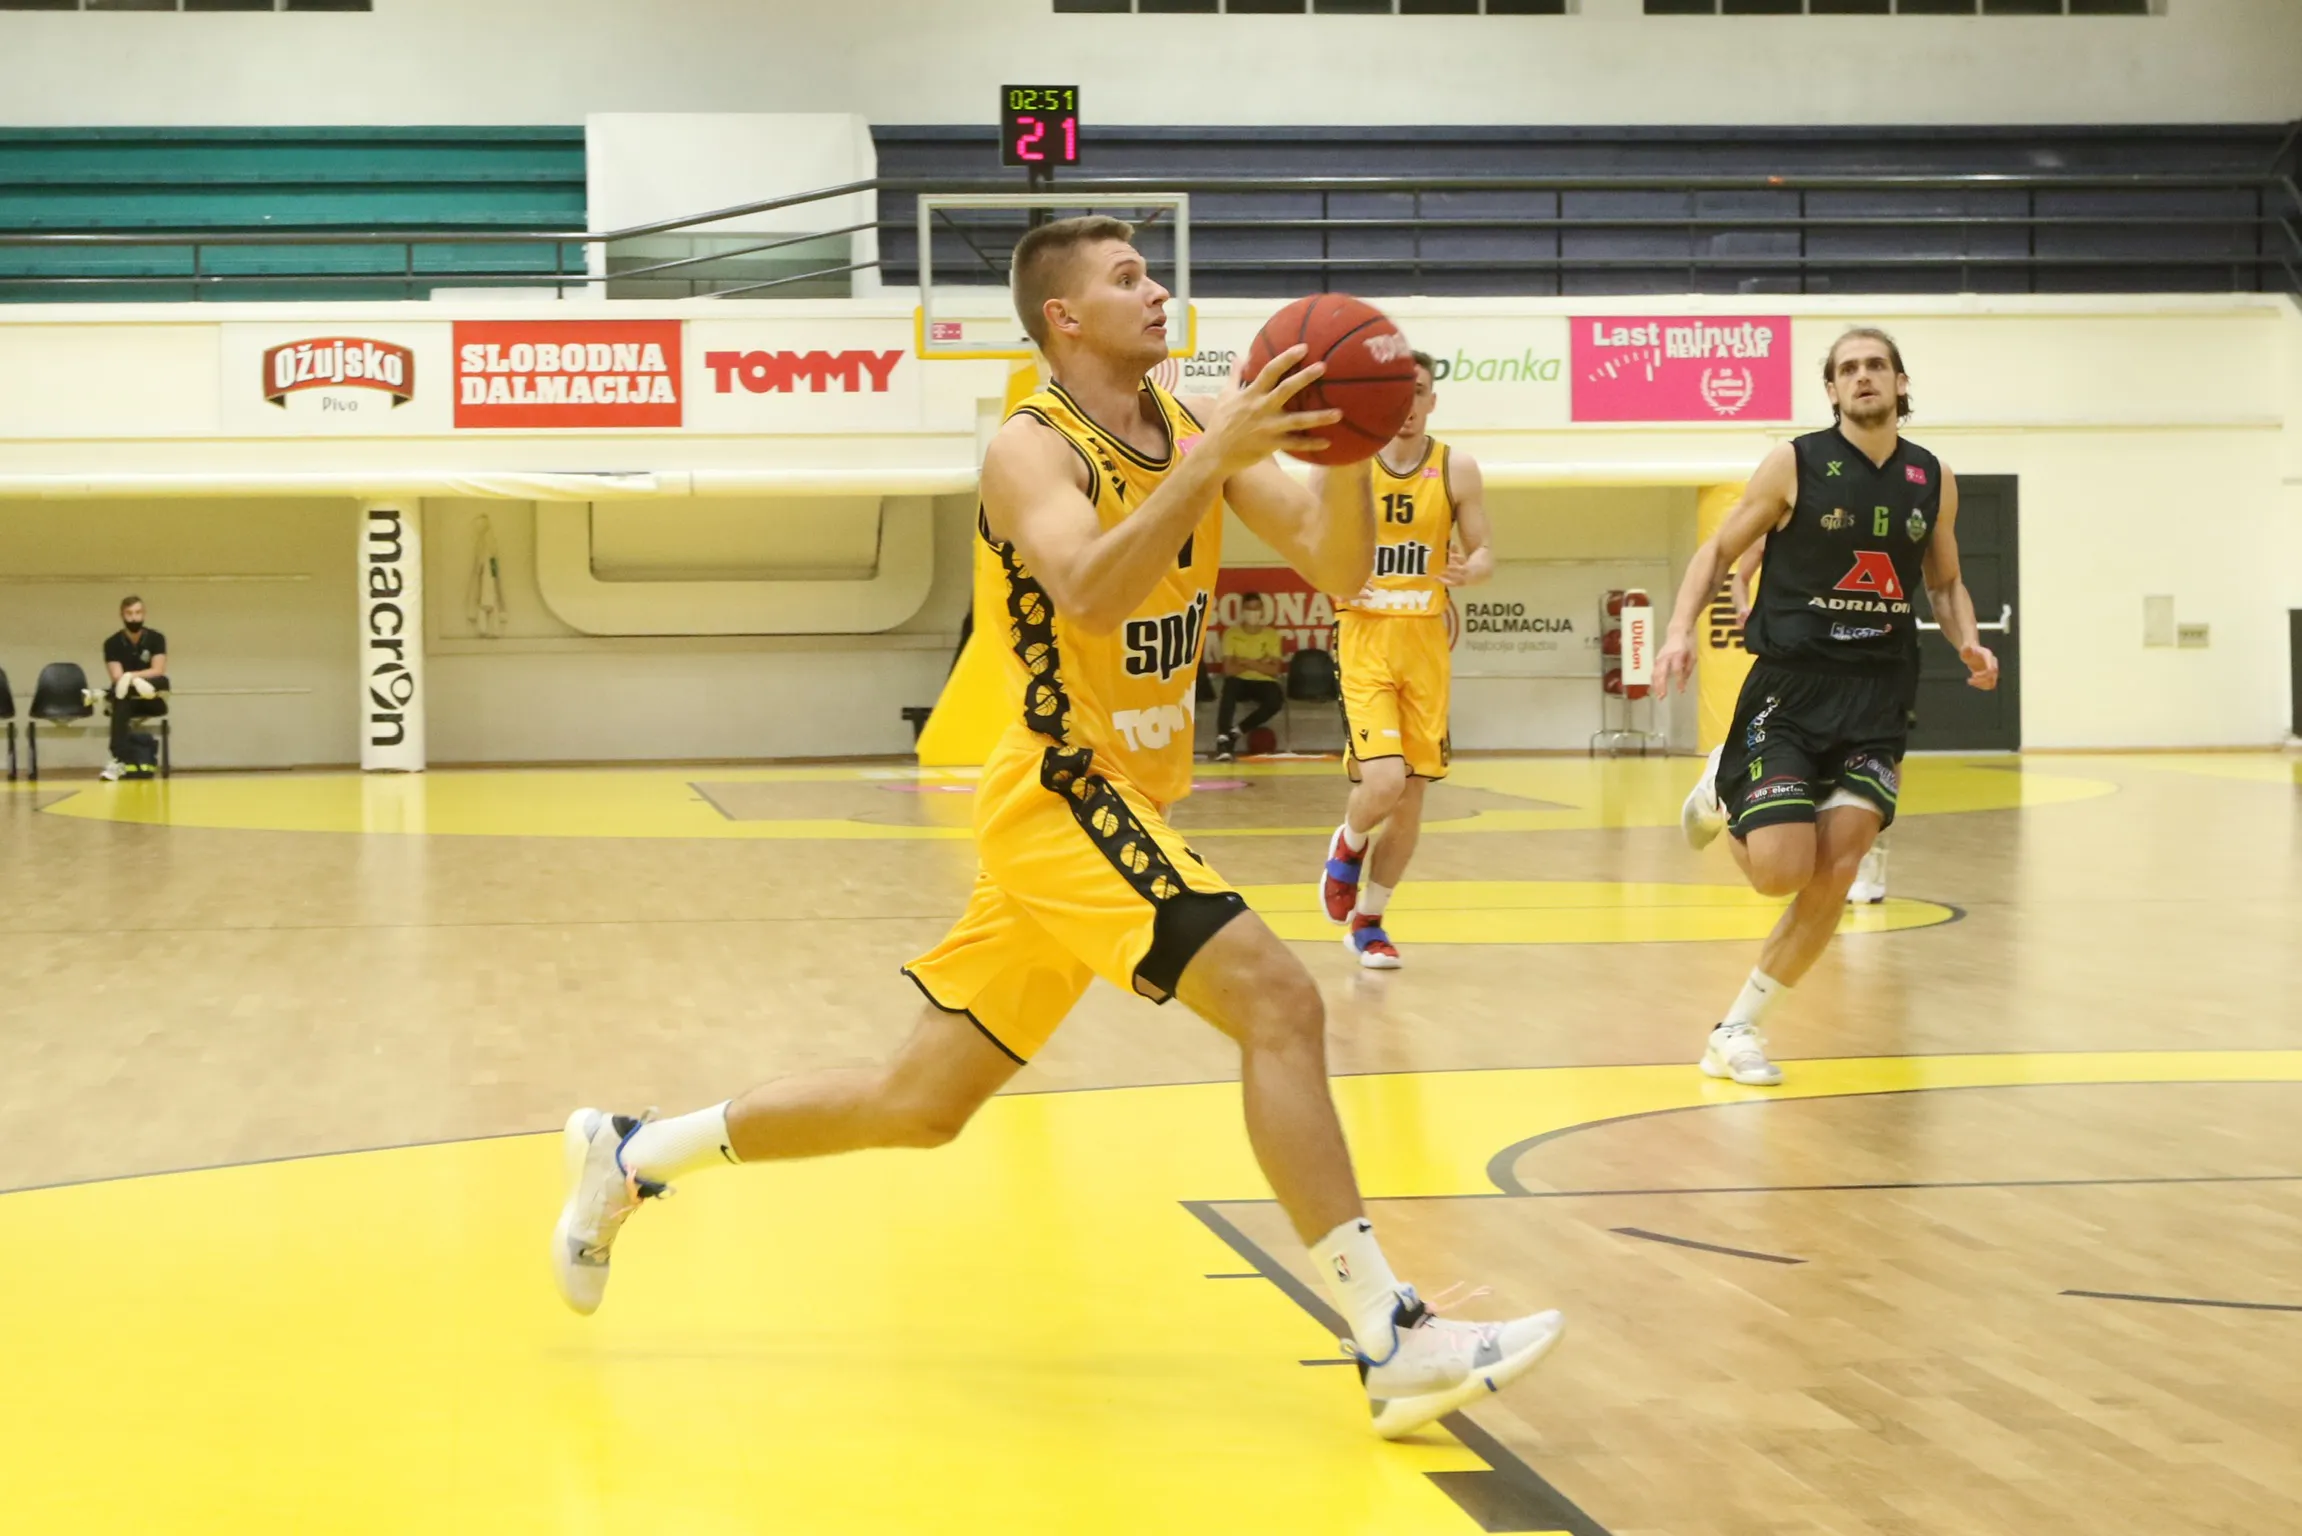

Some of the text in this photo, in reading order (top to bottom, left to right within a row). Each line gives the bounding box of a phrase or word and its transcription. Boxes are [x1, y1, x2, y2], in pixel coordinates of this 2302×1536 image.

[1009, 89, 1073, 110] 02:51
[1016, 117, 1076, 160] 21
[1593, 321, 1773, 346] Last minute
[275, 341, 403, 388] Ožujsko
[460, 343, 667, 373] SLOBODNA
[1666, 345, 1770, 358] RENT A CAR
[705, 350, 905, 393] TOMMY
[322, 397, 358, 411] Pivo
[460, 375, 677, 405] DALMACIJA
[1381, 493, 1414, 524] 15
[1873, 506, 1889, 536] 6
[1375, 541, 1431, 576] plit
[1466, 603, 1525, 617] RADIO
[1808, 597, 1888, 613] ADRIA
[368, 510, 414, 747] macron
[1466, 619, 1573, 633] DALMACIJA
[1631, 619, 1645, 670] Wilson
